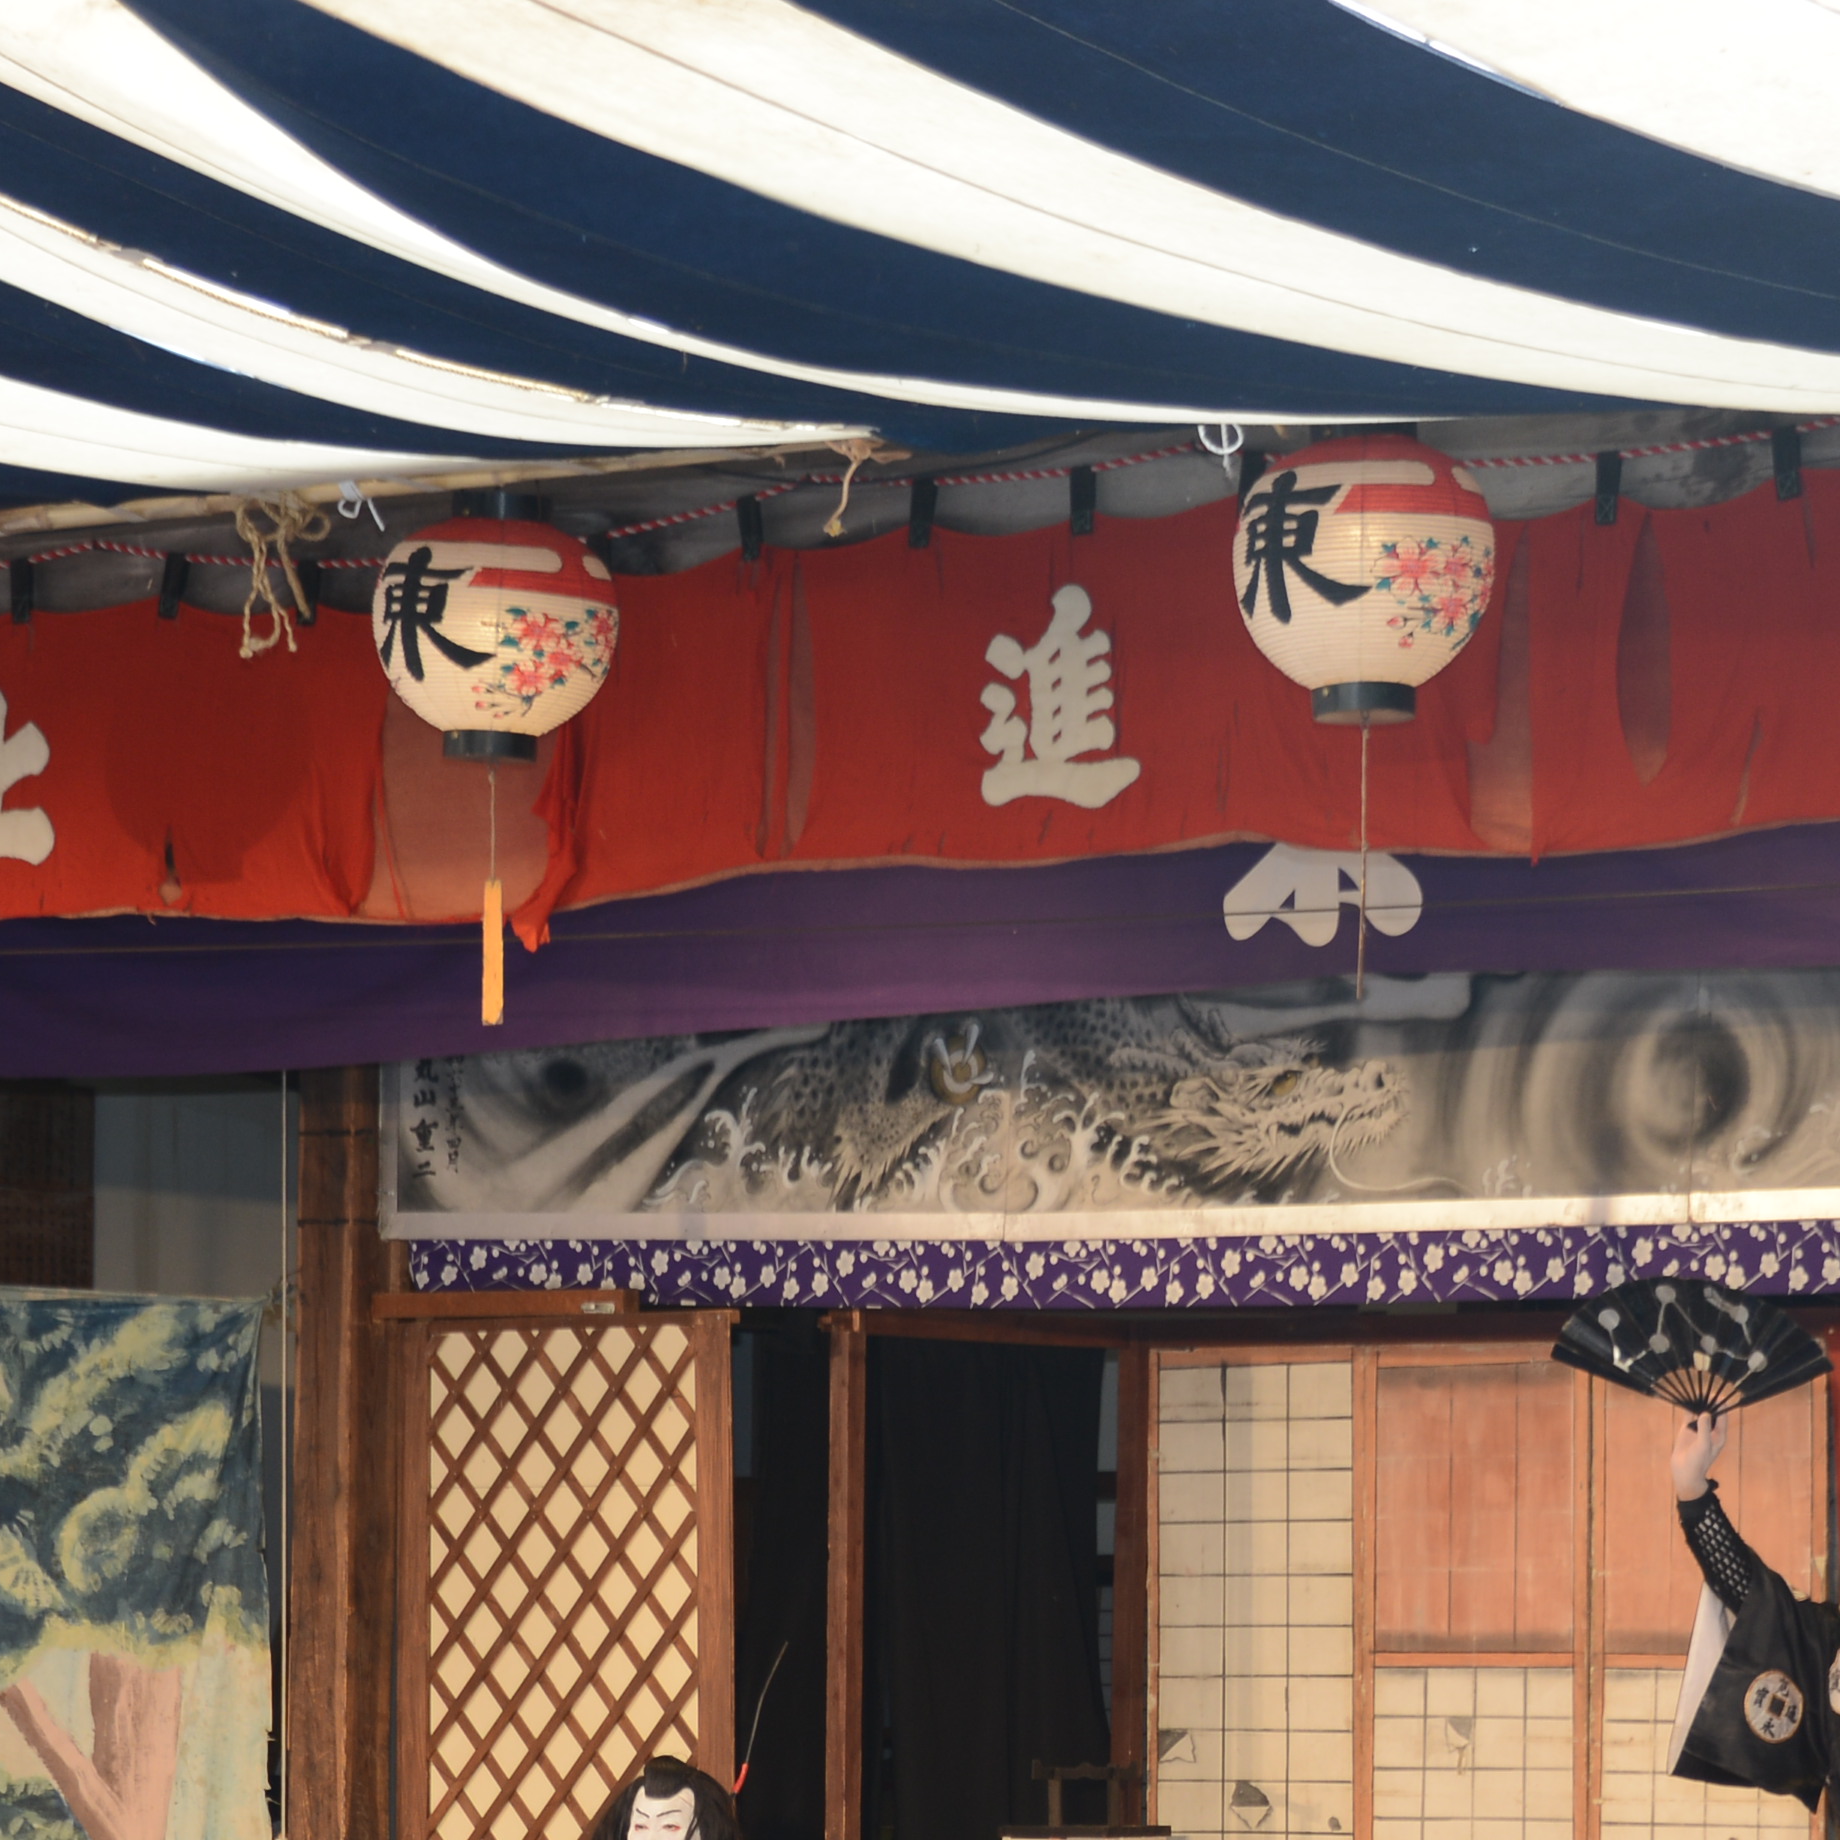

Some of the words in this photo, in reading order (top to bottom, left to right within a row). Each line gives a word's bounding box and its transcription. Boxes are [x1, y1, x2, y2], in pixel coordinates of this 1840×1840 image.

[380, 546, 496, 682] 東
[1237, 470, 1372, 624] 東
[979, 584, 1141, 809] 進
